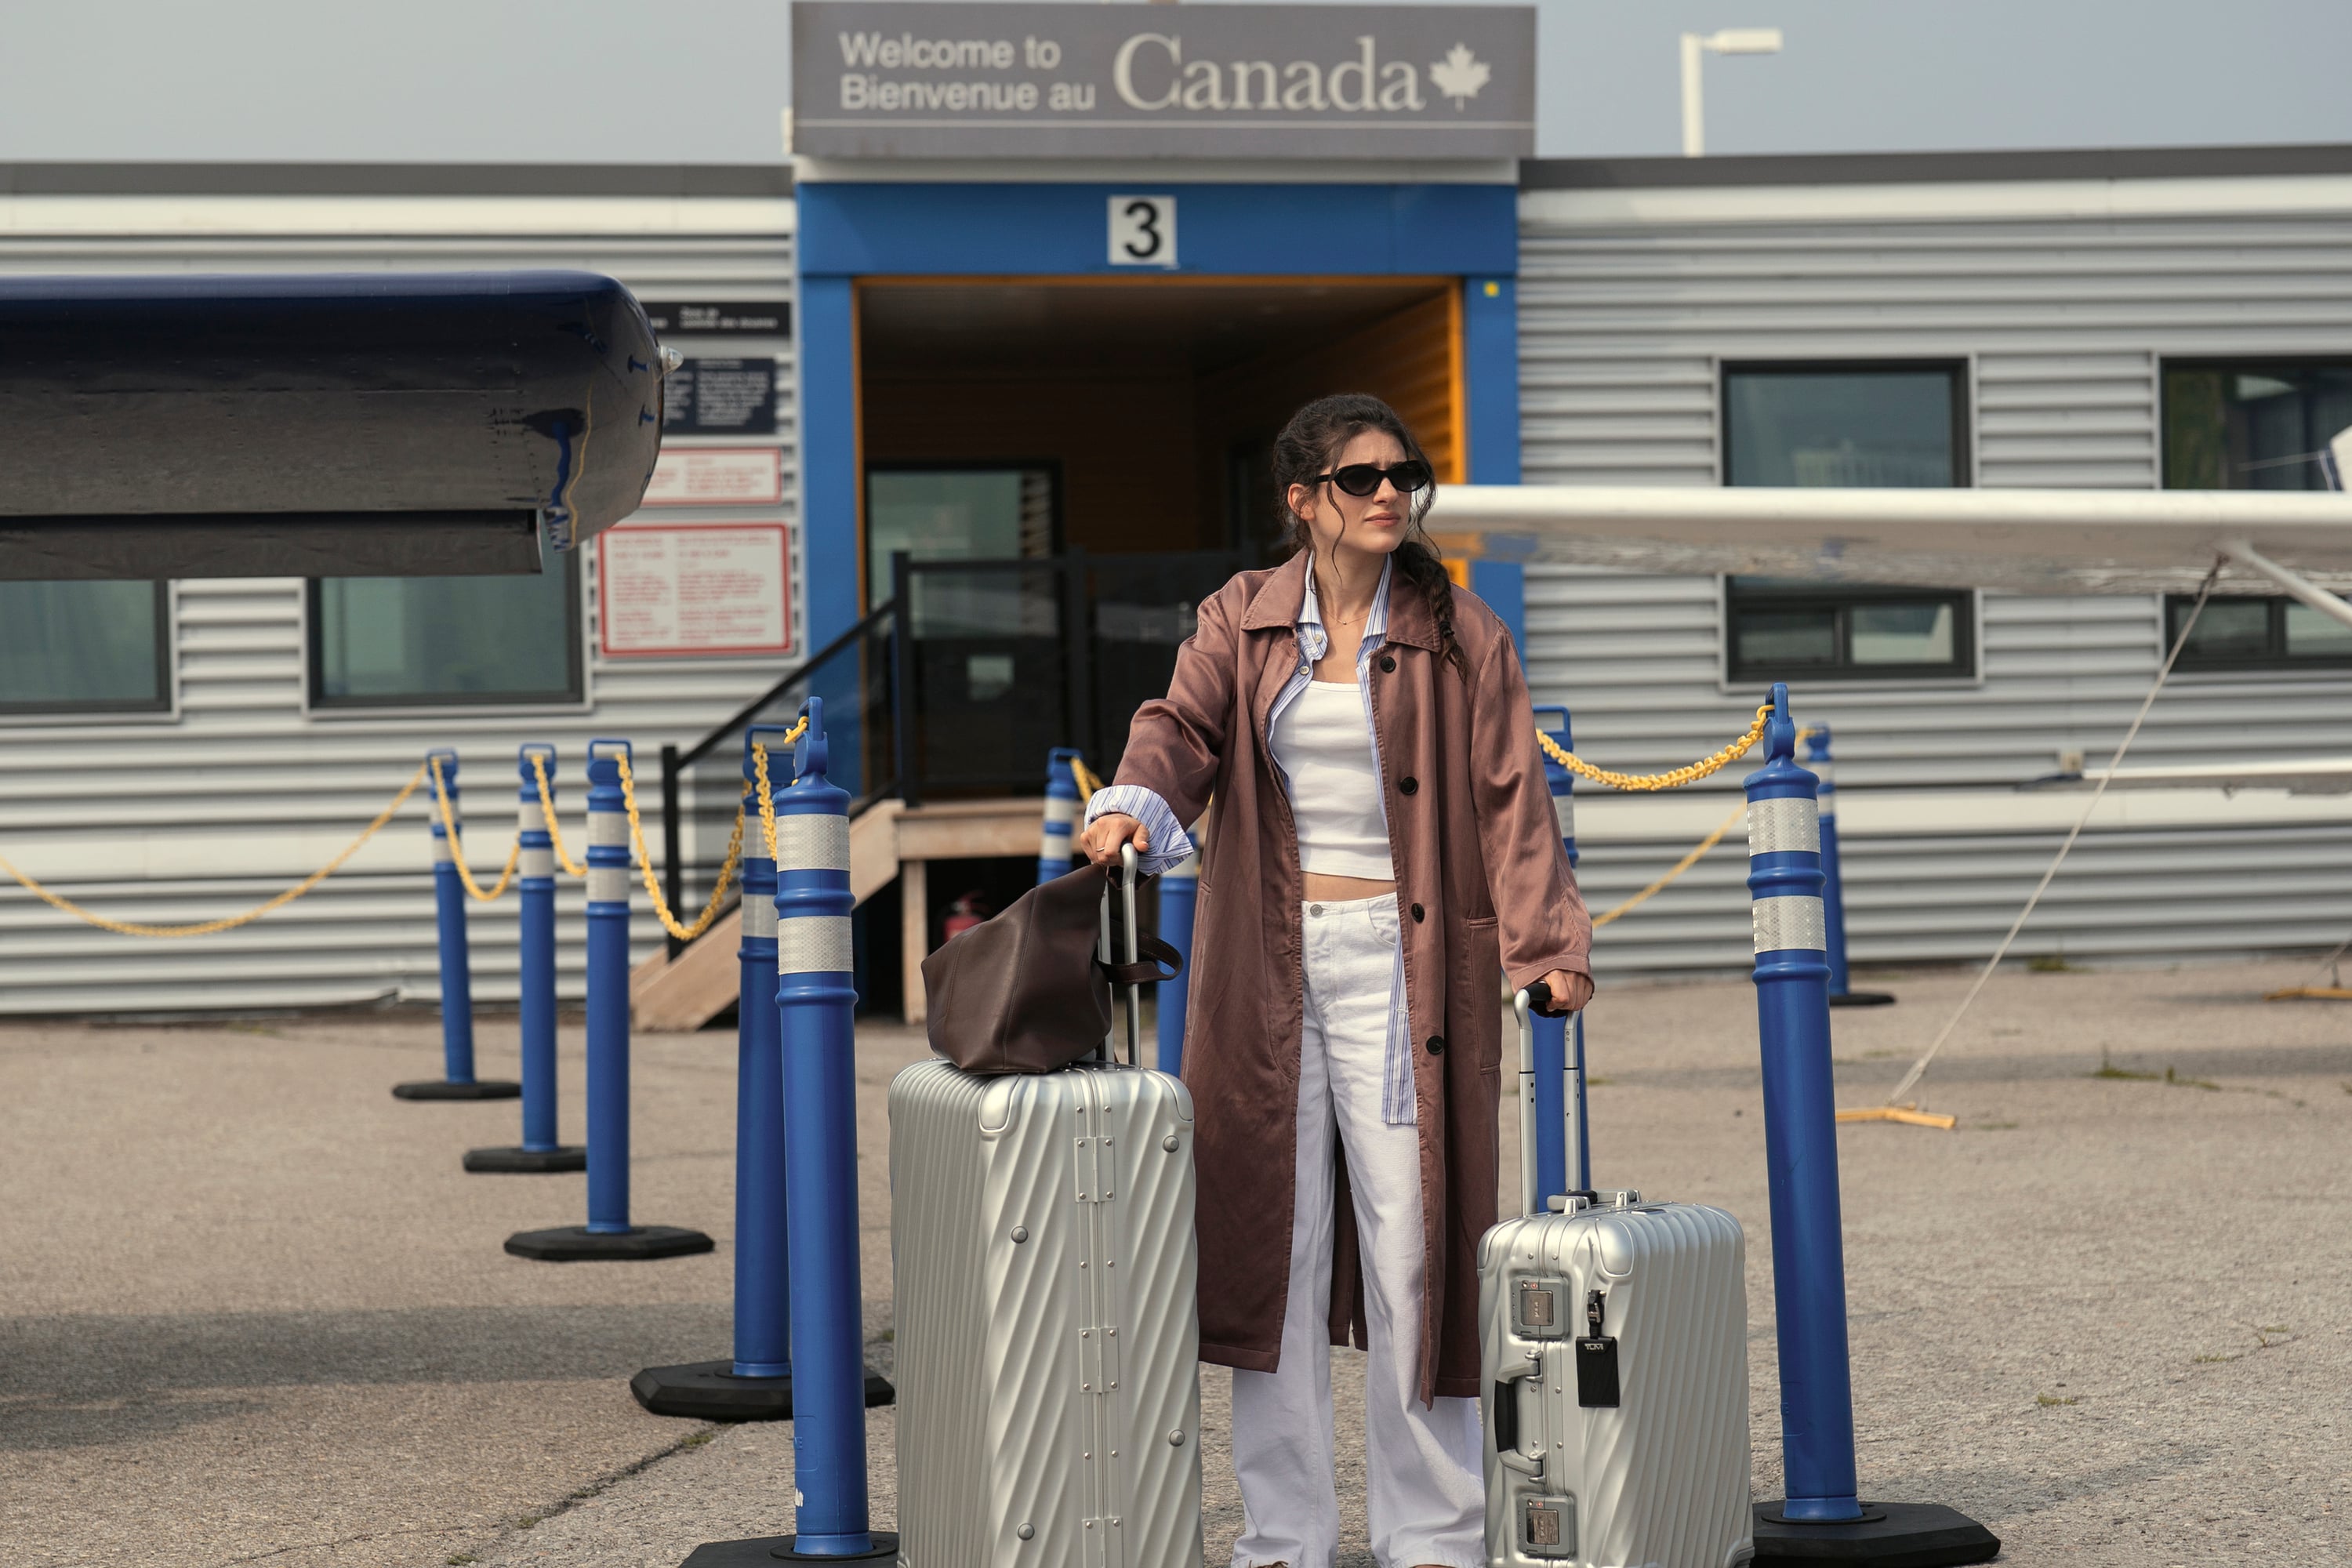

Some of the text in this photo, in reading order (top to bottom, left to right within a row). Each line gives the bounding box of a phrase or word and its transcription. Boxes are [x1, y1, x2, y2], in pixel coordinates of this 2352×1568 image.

[839, 31, 1061, 68] Welcome to
[1113, 33, 1426, 111] Canada
[840, 74, 1095, 111] Bienvenue au
[1123, 198, 1163, 259] 3
